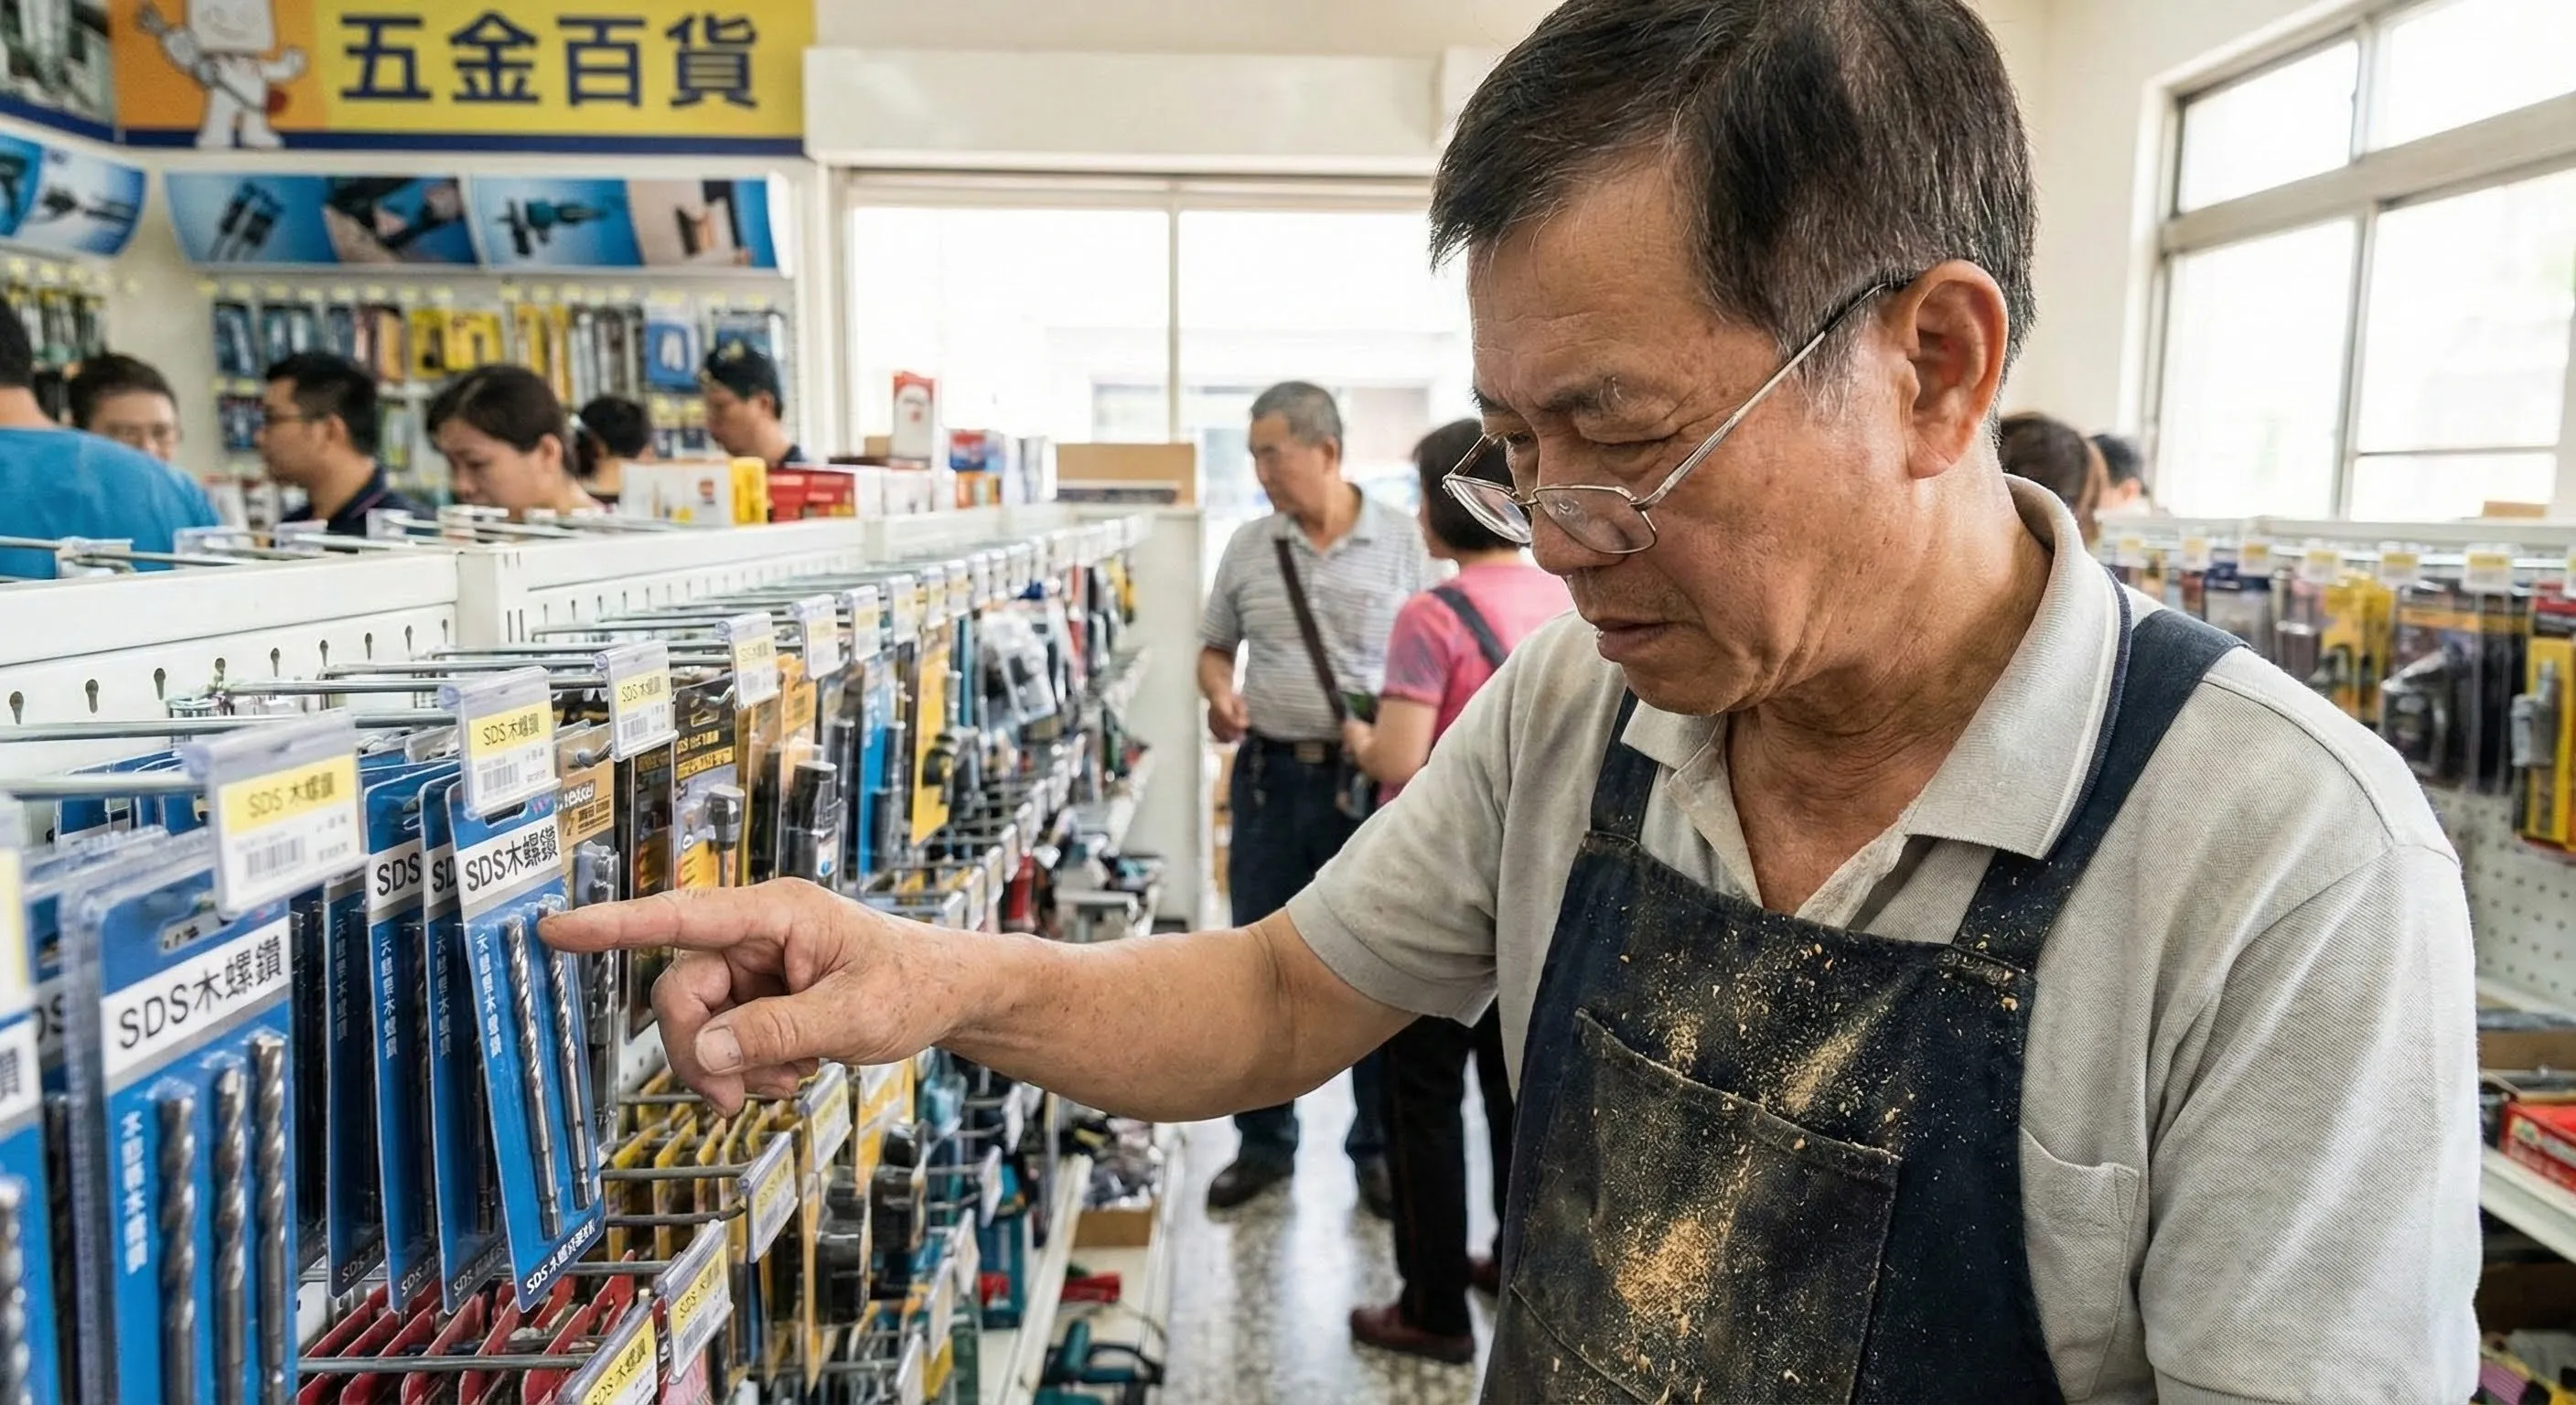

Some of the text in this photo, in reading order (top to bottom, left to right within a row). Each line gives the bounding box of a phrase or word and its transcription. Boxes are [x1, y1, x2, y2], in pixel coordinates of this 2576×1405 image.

[339, 10, 758, 108] 五金百貨
[482, 723, 506, 745] SDS
[377, 852, 422, 896] SDS
[119, 934, 283, 1050] SDS木螺鑽
[526, 1260, 549, 1295] SDS
